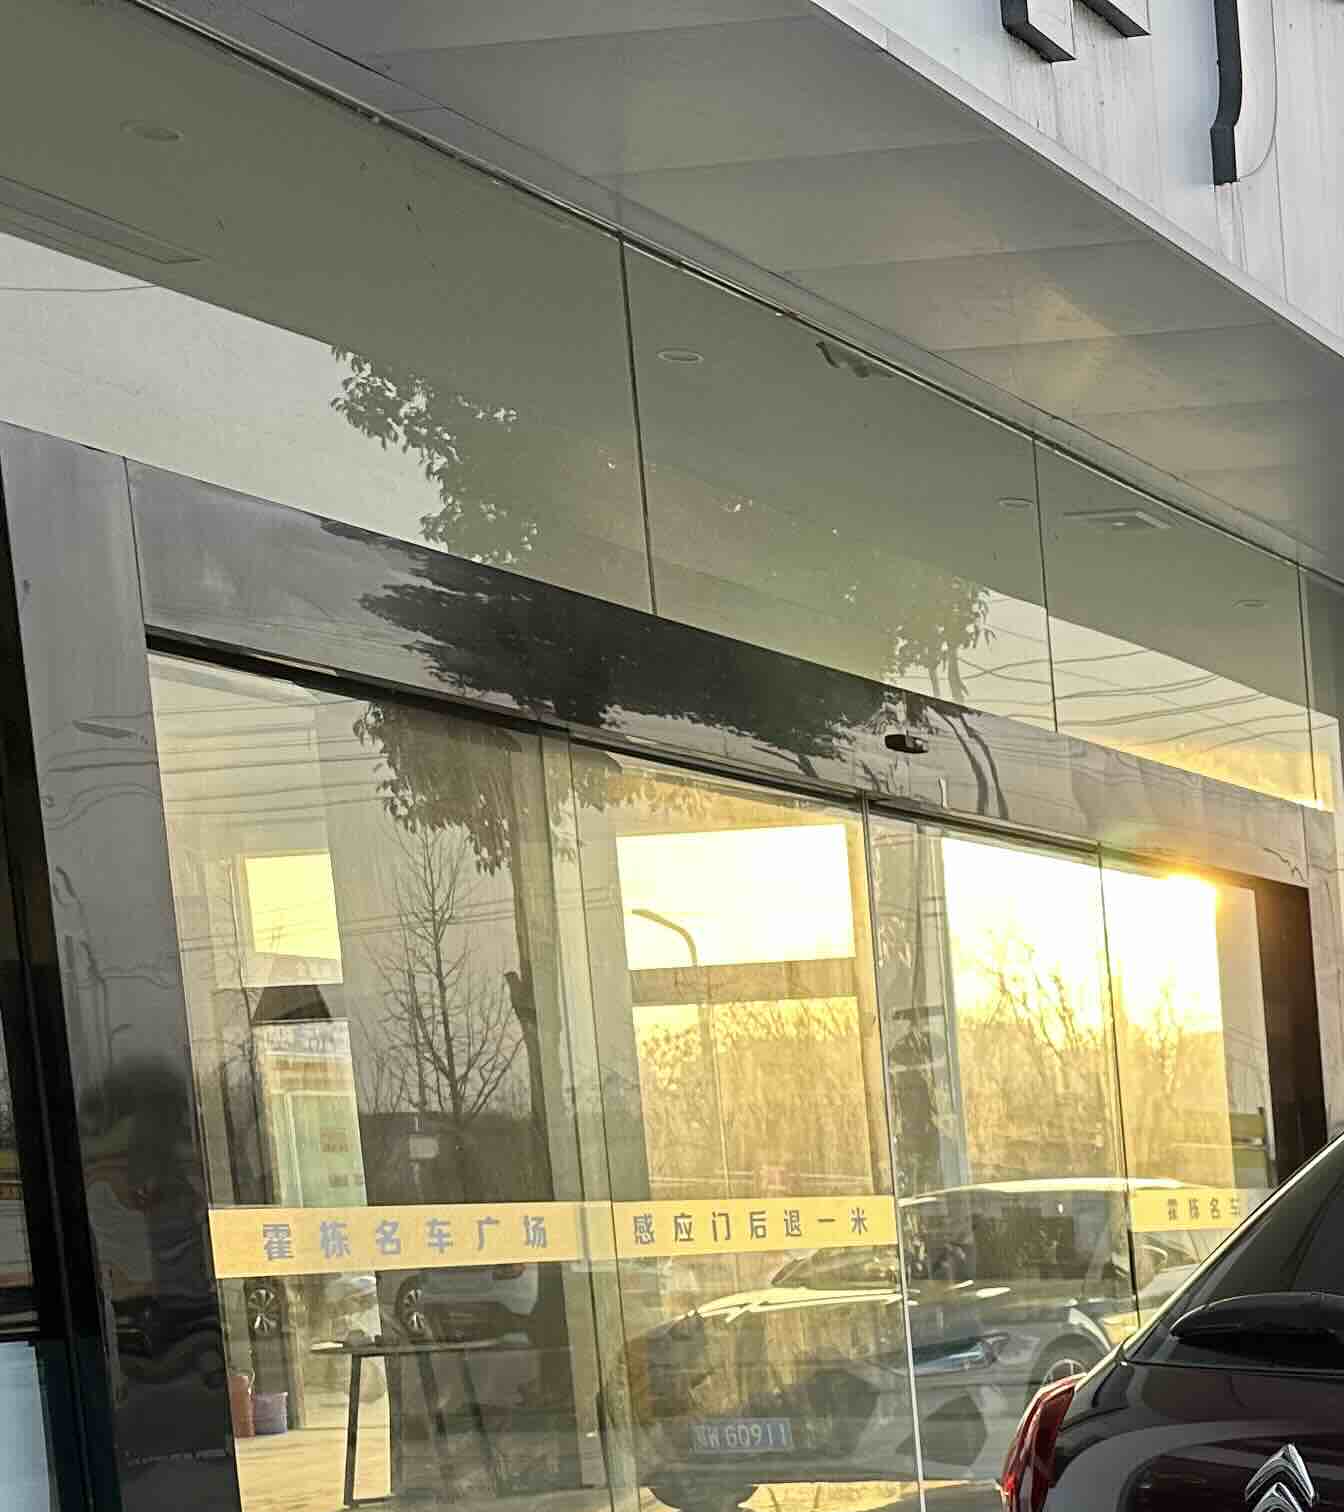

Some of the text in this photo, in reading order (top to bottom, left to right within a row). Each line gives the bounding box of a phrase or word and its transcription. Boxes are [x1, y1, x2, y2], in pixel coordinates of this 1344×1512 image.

[262, 1216, 548, 1261] 霍栋名车广场
[633, 1207, 868, 1244] 感应门后退一米
